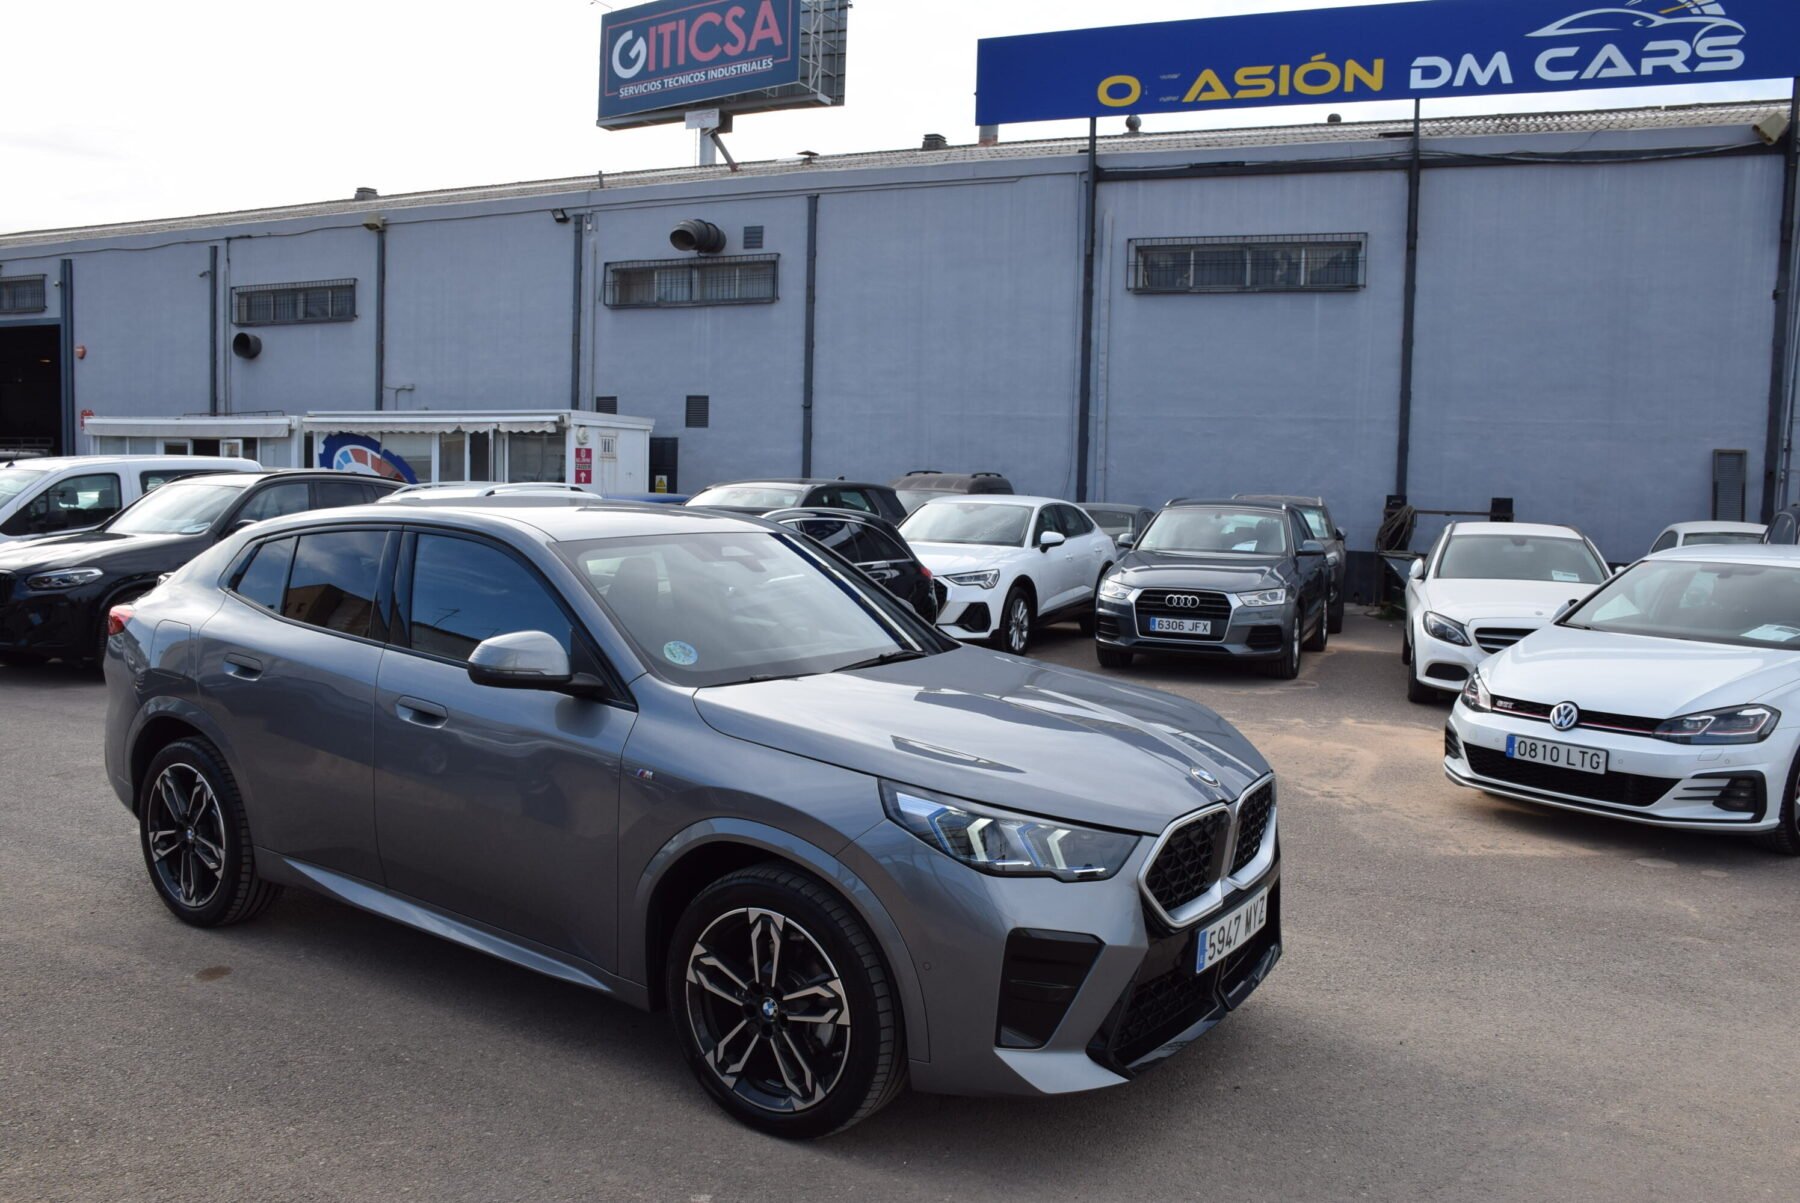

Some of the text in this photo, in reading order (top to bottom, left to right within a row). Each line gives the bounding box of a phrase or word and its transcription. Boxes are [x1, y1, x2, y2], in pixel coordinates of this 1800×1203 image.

[612, 0, 782, 79] GITICSA
[619, 58, 773, 98] SERVICIOS TECNICOS INDUSTRIALES
[1097, 35, 1746, 107] OASIÓN DM CARS
[1157, 619, 1209, 633] 6306 JFX
[1518, 740, 1601, 770] 0810 LTG
[1208, 895, 1265, 961] 5947 MYZ
